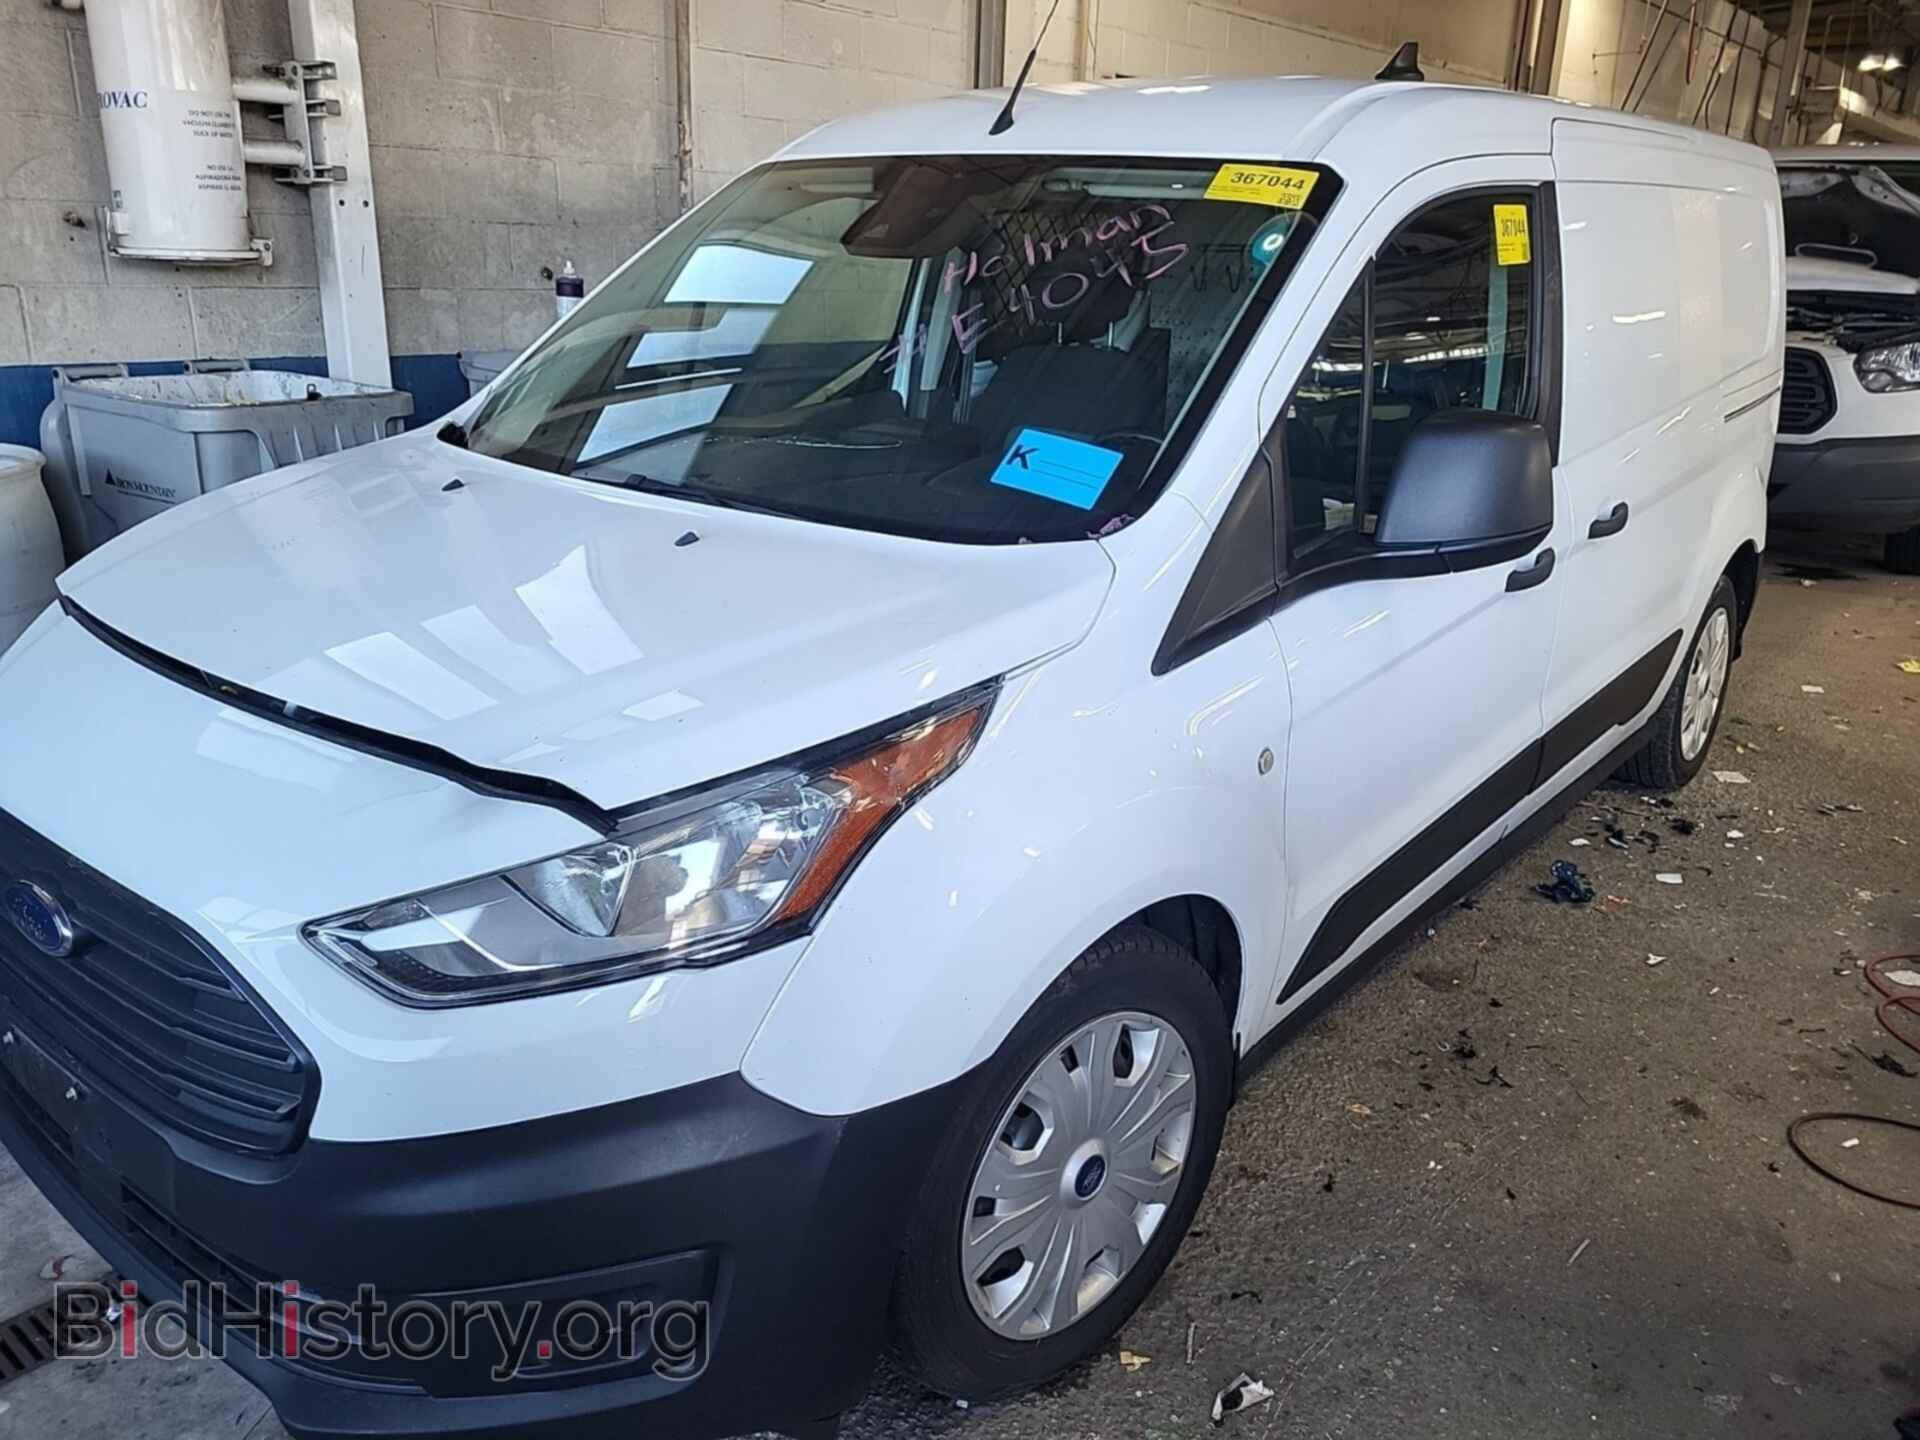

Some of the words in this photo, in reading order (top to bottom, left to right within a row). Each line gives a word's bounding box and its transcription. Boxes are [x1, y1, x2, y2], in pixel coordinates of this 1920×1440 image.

[1230, 172, 1305, 190] 367044
[943, 204, 1171, 294] Holman
[1006, 444, 1040, 471] K
